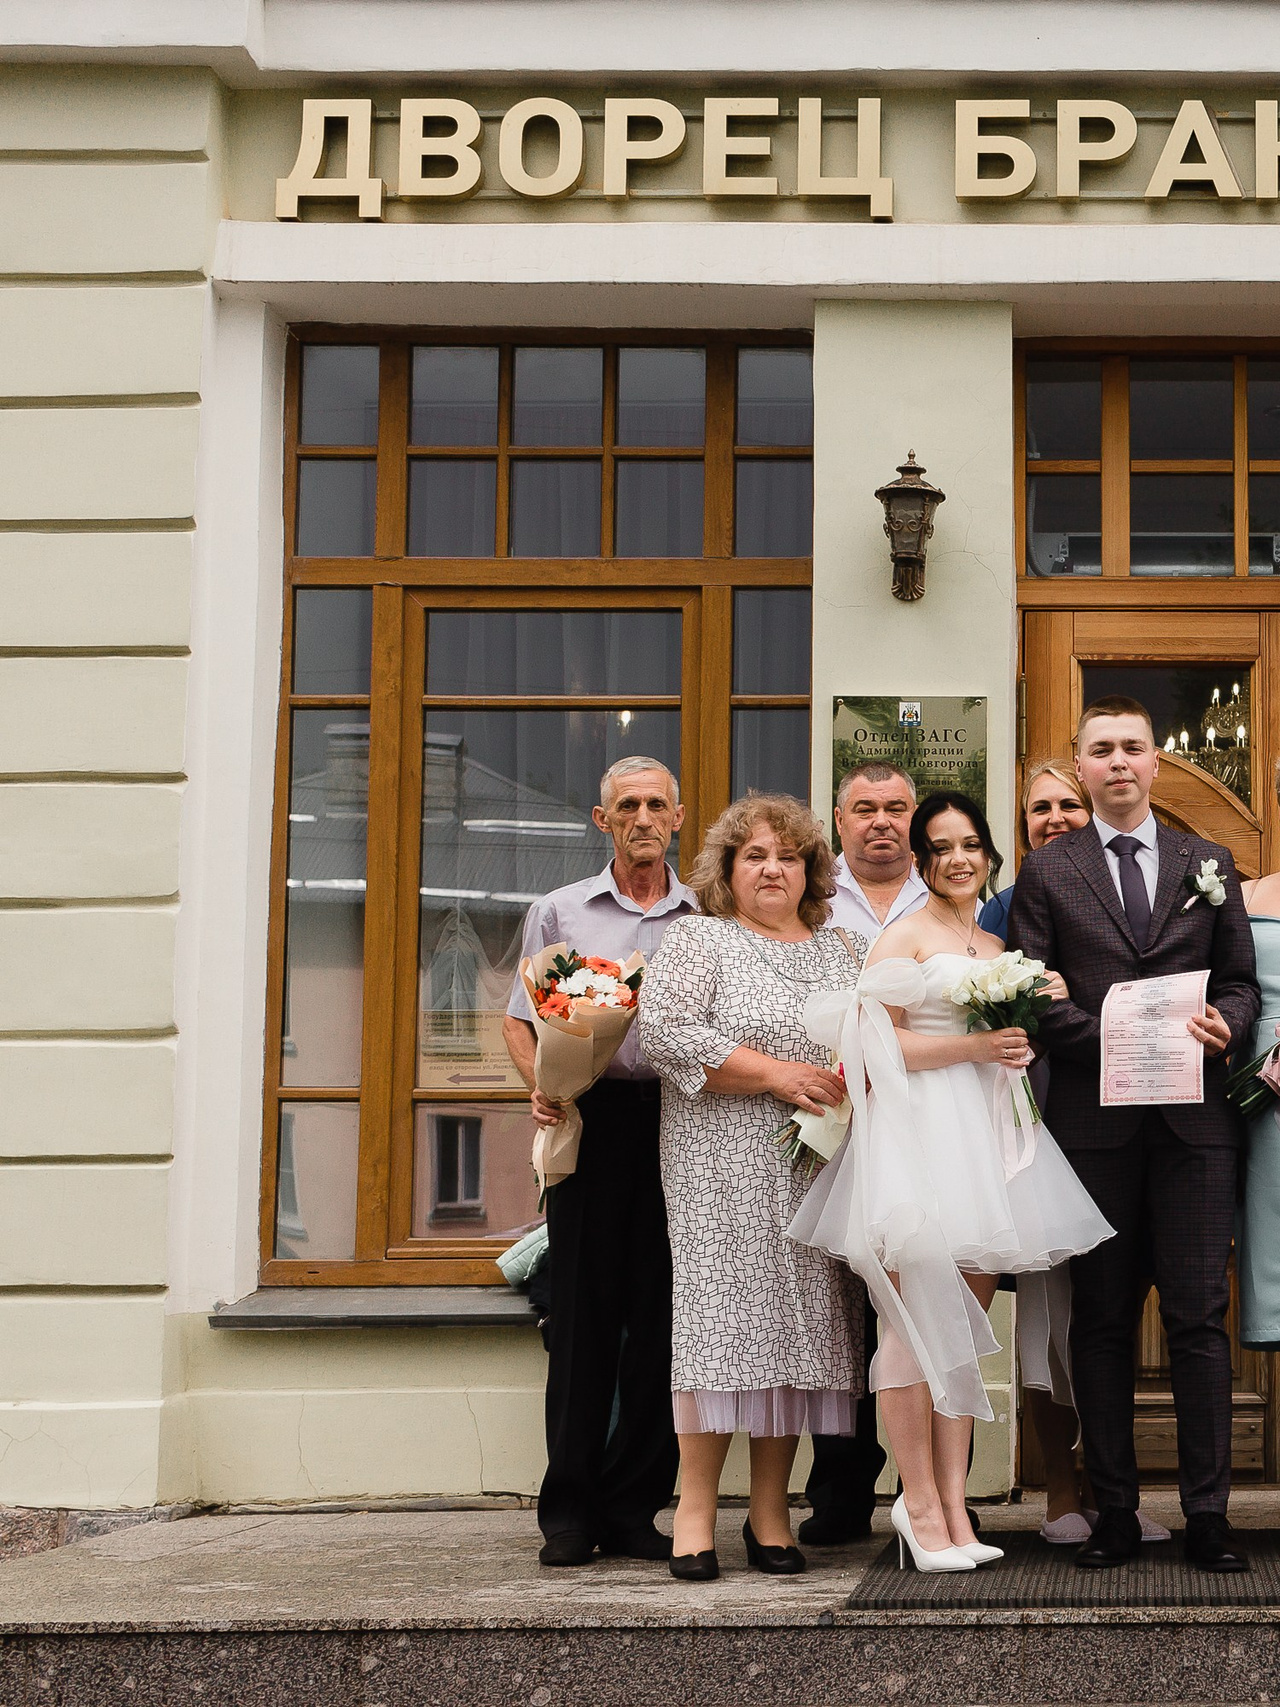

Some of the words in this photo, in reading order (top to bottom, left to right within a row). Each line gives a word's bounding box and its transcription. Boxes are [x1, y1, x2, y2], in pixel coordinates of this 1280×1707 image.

[275, 97, 894, 222] ДВОРЕЦ
[853, 728, 909, 744] Отдел
[915, 728, 967, 742] ЗАГС
[856, 745, 964, 757] Администрации
[907, 757, 978, 771] Новгорода
